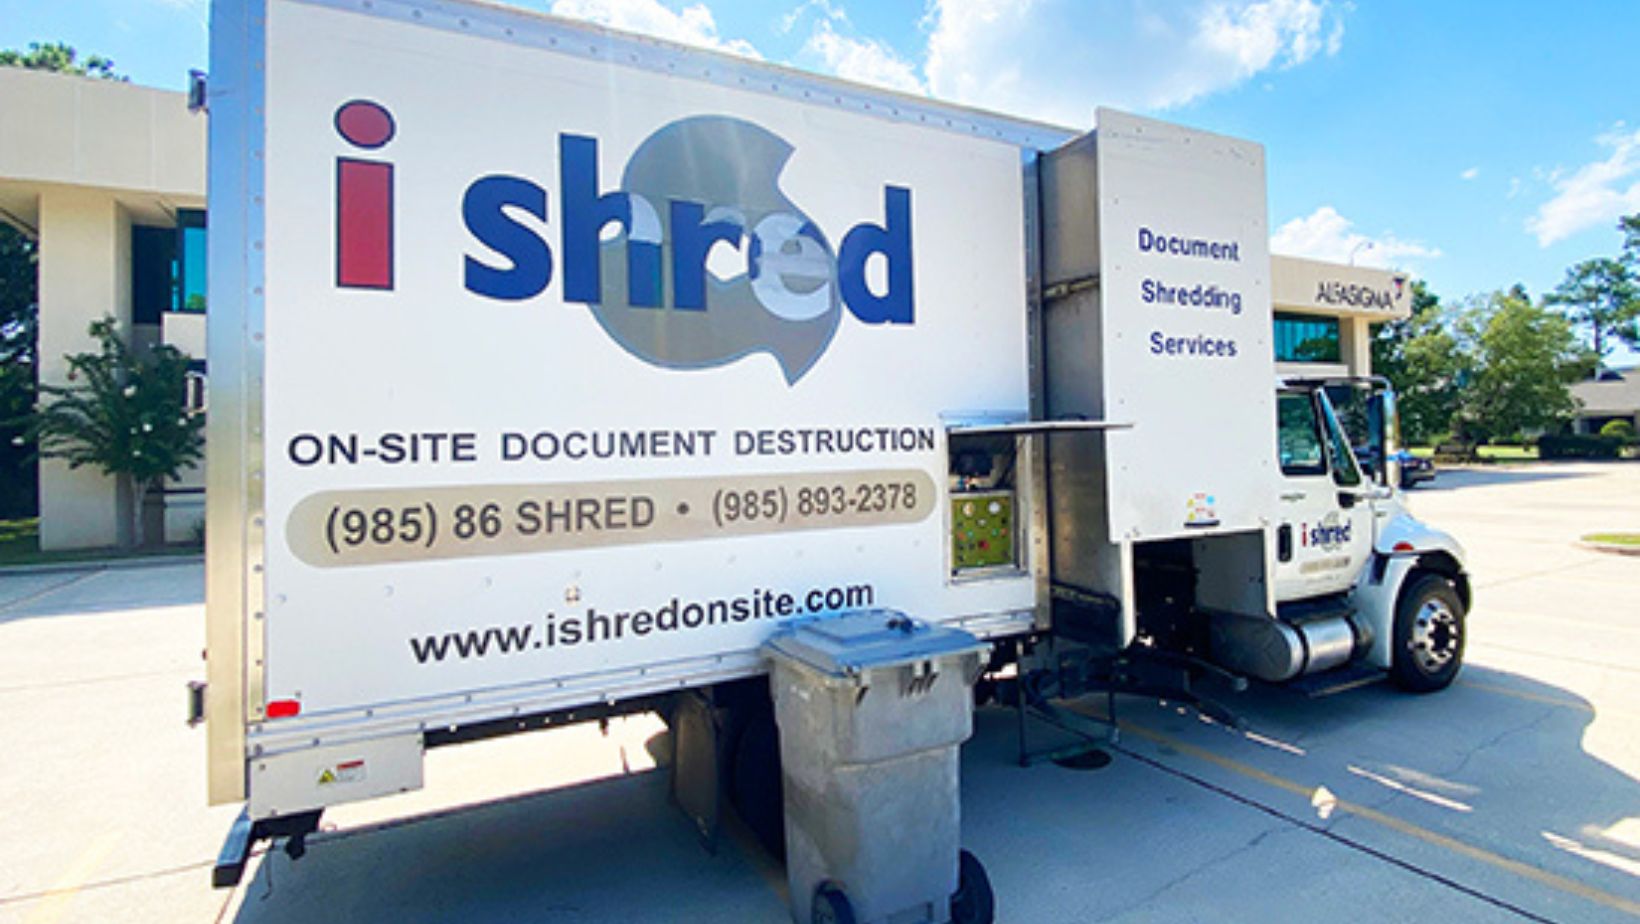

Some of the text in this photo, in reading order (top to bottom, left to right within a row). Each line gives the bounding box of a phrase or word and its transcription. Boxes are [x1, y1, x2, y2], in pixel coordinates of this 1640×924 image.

[334, 99, 916, 325] i shred
[1138, 227, 1240, 261] Document
[1141, 278, 1242, 315] Shredding
[1150, 331, 1238, 357] Services
[287, 427, 935, 466] ON-SITE DOCUMENT DESTRUCTION
[326, 482, 917, 554] (985) 86 SHRED (985) 893-2378
[1310, 517, 1352, 547] shred
[410, 583, 874, 664] www.ishredonsite.com
